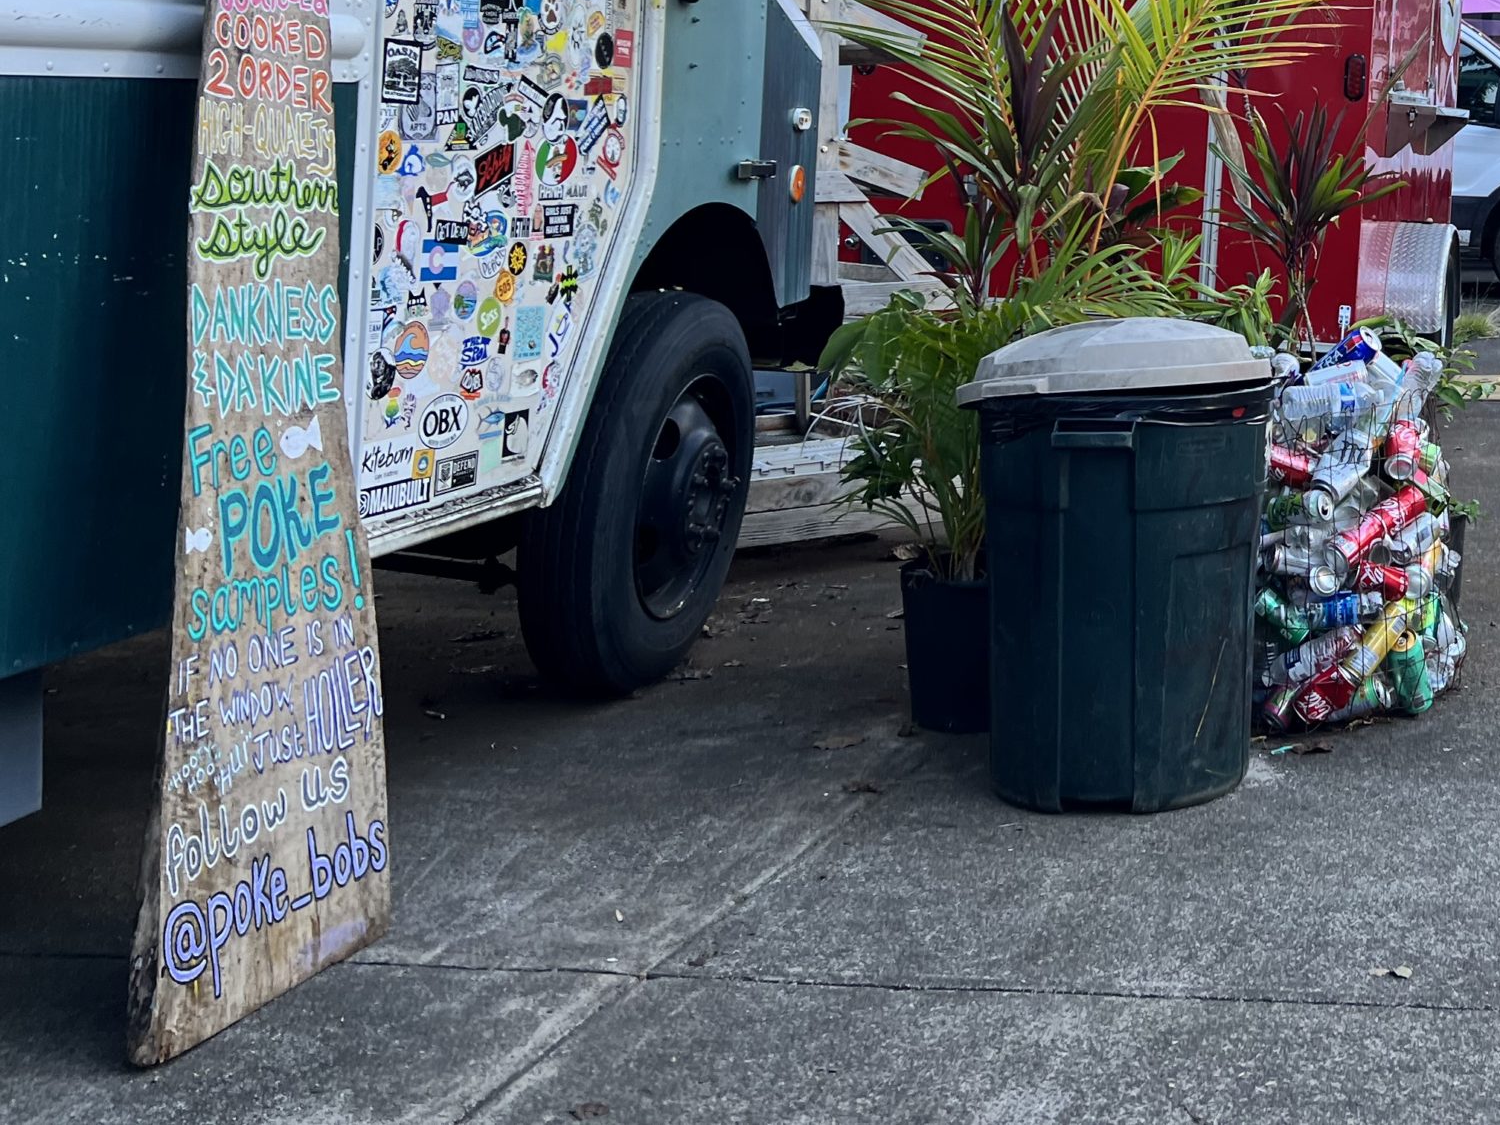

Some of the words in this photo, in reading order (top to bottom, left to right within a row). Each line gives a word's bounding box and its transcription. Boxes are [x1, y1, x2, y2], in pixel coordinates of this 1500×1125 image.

[215, 12, 326, 61] COOKED
[387, 47, 419, 62] OASIS
[204, 48, 236, 100] 2
[237, 54, 333, 116] ORDER
[436, 110, 458, 125] PAN
[191, 278, 337, 349] DANKNESS
[461, 345, 489, 363] SPOT
[462, 335, 491, 348] THE
[422, 404, 463, 438] OBX
[187, 423, 278, 497] Free
[218, 461, 342, 577] POKE
[368, 477, 431, 515] MAUIBUILT
[178, 654, 199, 696] IF
[209, 640, 238, 688] NO
[249, 625, 299, 673] ONE
[306, 619, 325, 656] IS
[333, 617, 356, 648] IN
[169, 697, 210, 744] THE
[303, 645, 383, 756] HOLLER
